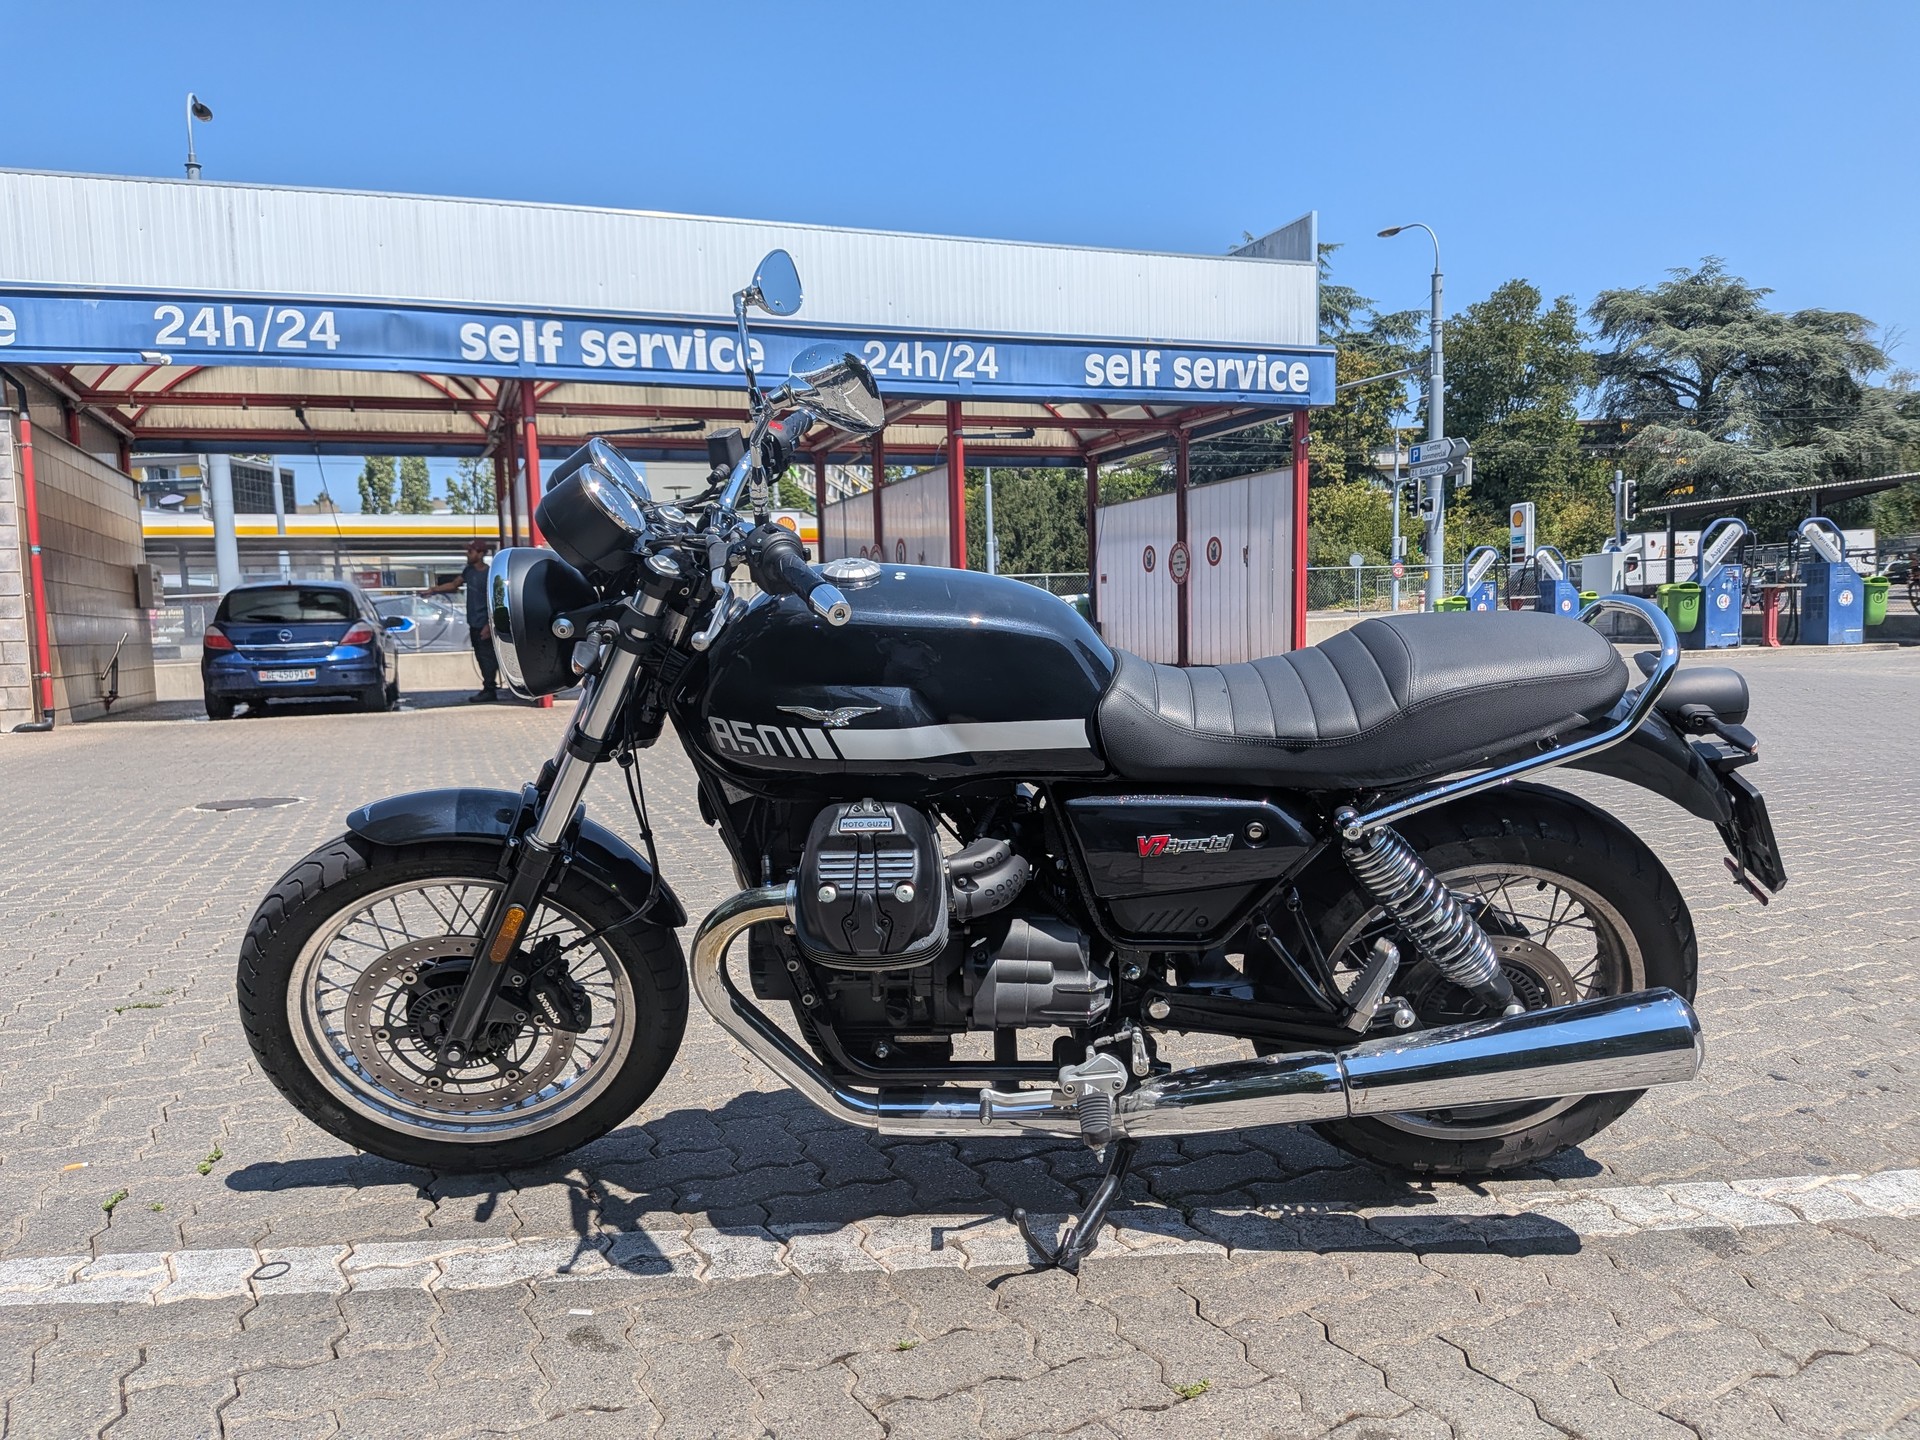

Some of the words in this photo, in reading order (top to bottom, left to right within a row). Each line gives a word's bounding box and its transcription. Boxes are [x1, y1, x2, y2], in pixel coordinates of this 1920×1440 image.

[153, 304, 341, 352] 24h/24
[459, 320, 564, 364] self
[580, 328, 765, 374] service
[863, 340, 999, 382] 24h/24
[1085, 350, 1161, 387] self
[1173, 354, 1309, 393] service
[1421, 449, 1447, 461] commercial
[1426, 443, 1441, 452] Centre
[1711, 530, 1736, 559] Aspirateur
[1813, 530, 1839, 557] Aspirateur
[866, 820, 890, 828] GUZZI
[1137, 834, 1171, 857] V7
[536, 991, 561, 1024] brembo
